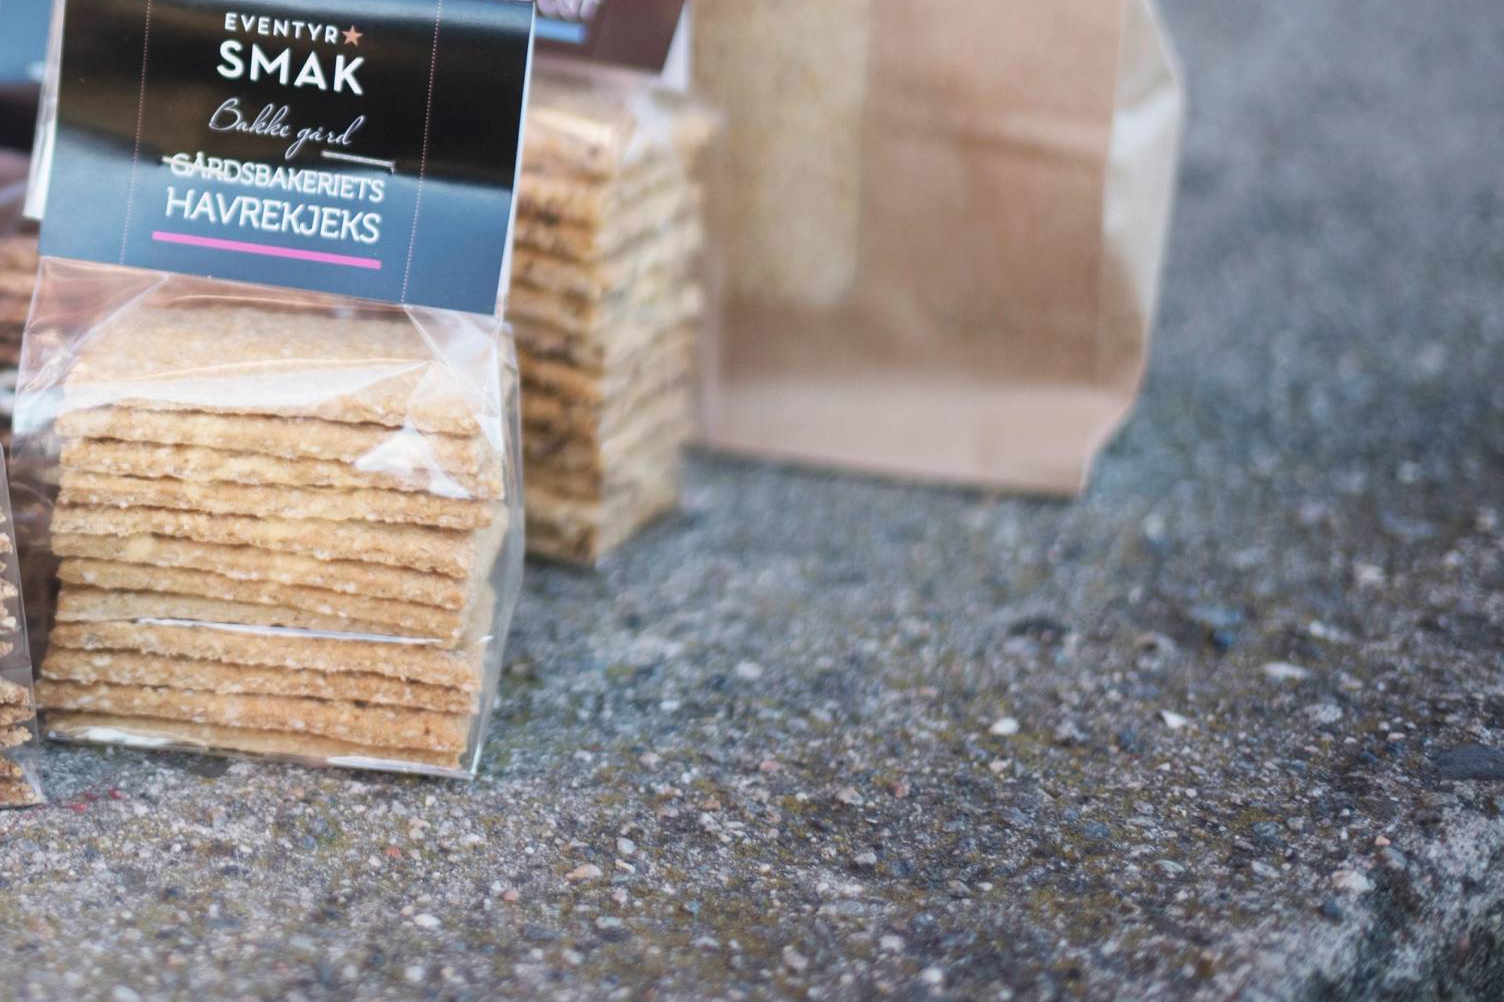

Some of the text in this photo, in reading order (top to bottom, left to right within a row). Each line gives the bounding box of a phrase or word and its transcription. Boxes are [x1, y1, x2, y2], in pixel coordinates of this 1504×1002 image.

[225, 12, 339, 45] EVENTYR
[216, 39, 365, 95] SMAK
[208, 97, 366, 160] Bakke gård
[170, 151, 386, 203] GÅRDSBAKERIETS
[166, 186, 381, 244] HAVREKJEKS
